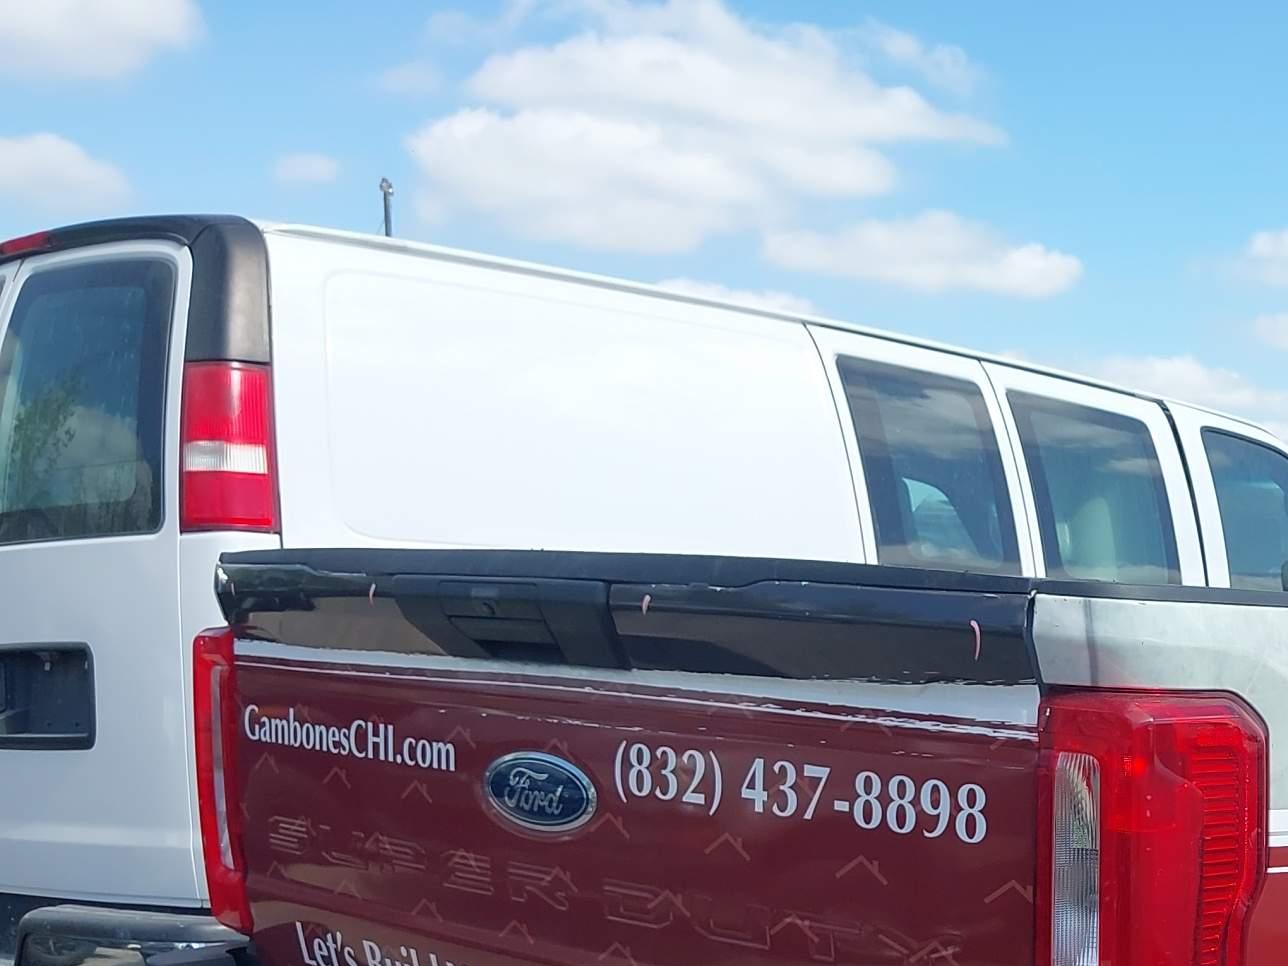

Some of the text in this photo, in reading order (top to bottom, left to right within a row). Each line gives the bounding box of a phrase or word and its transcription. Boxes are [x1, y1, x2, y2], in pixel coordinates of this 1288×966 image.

[244, 704, 456, 772] GambonesCHI.com
[504, 766, 565, 816] Ford
[614, 740, 988, 844] (832) 437-8898
